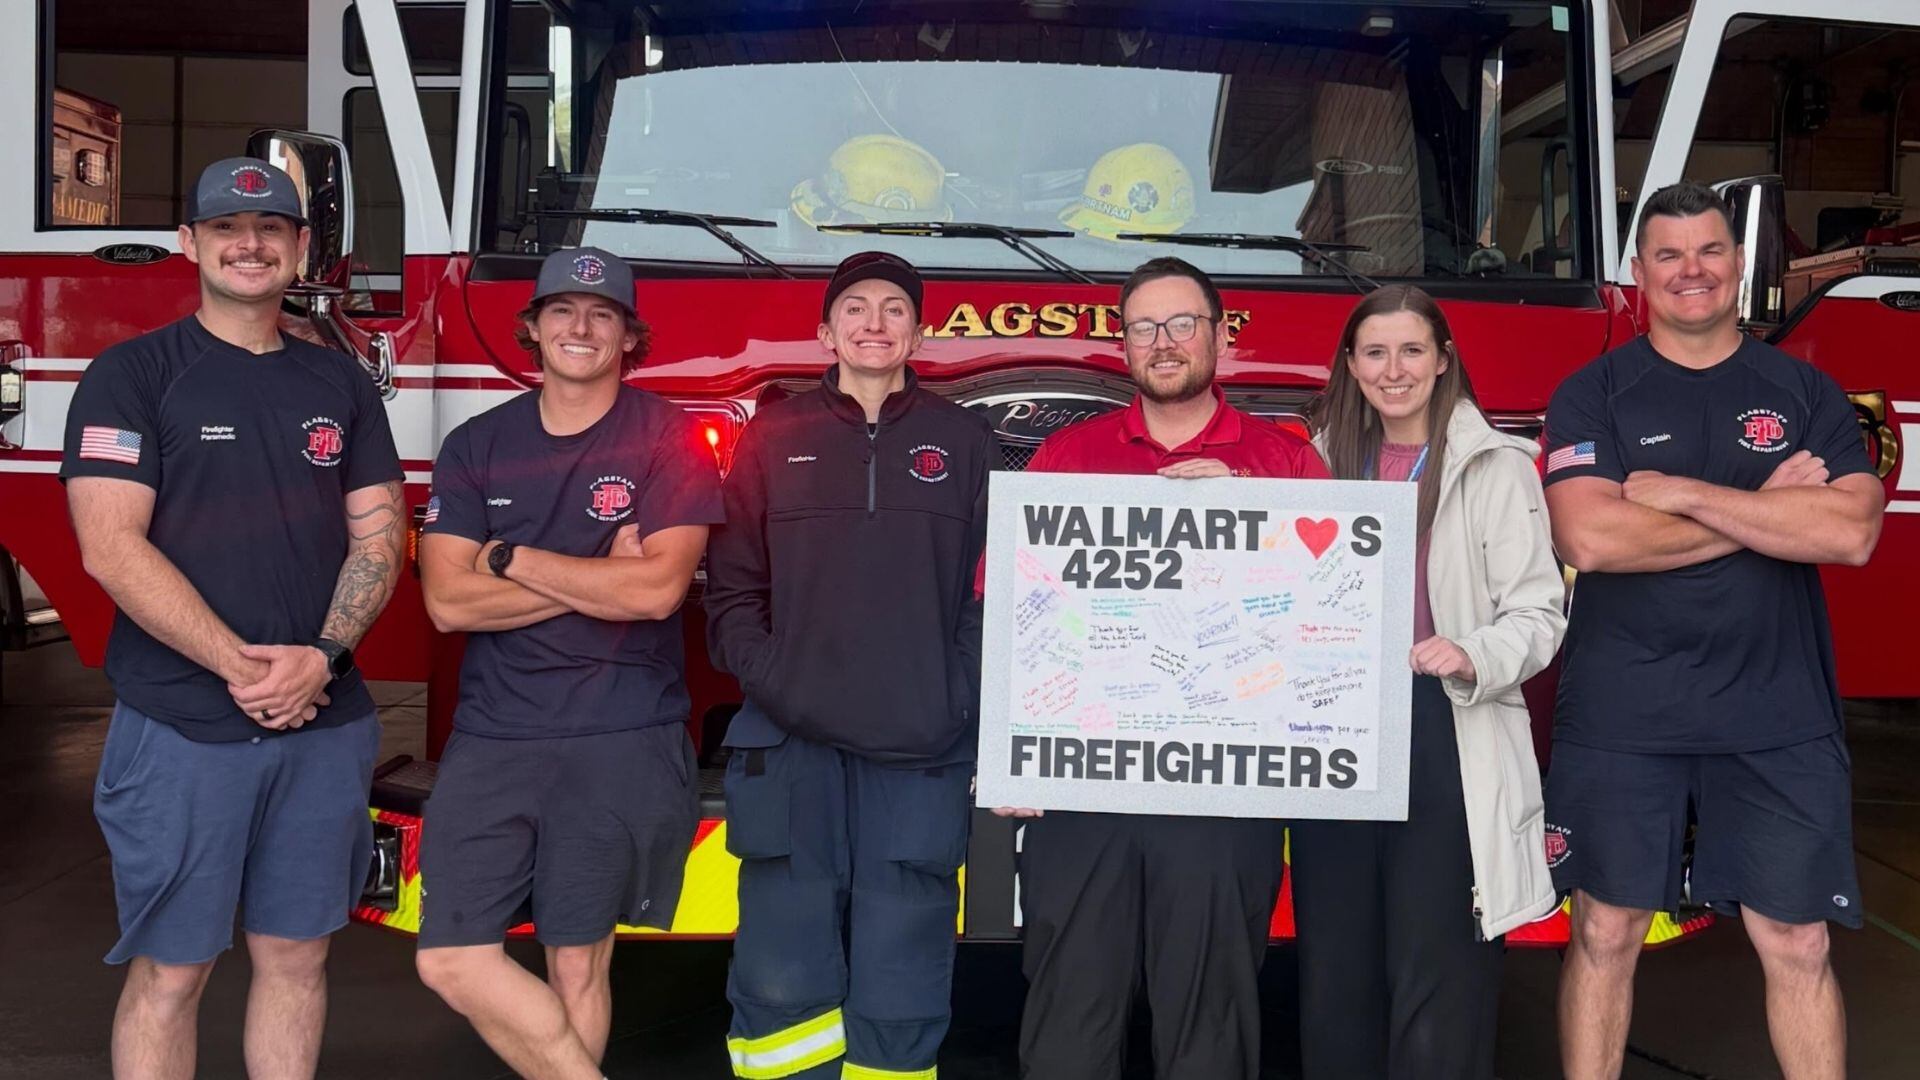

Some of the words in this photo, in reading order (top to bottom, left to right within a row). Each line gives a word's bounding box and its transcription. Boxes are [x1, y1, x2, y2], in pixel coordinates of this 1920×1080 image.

[1737, 409, 1788, 424] FLAGSTAFF
[201, 433, 236, 441] Paramedic
[202, 426, 234, 434] Firefighter
[1640, 433, 1672, 446] Captain
[1024, 505, 1268, 551] WALMART
[1351, 515, 1382, 557] S
[1062, 549, 1183, 590] 4252
[1287, 676, 1316, 690] Thank
[1010, 736, 1358, 789] FIREFIGHTERS
